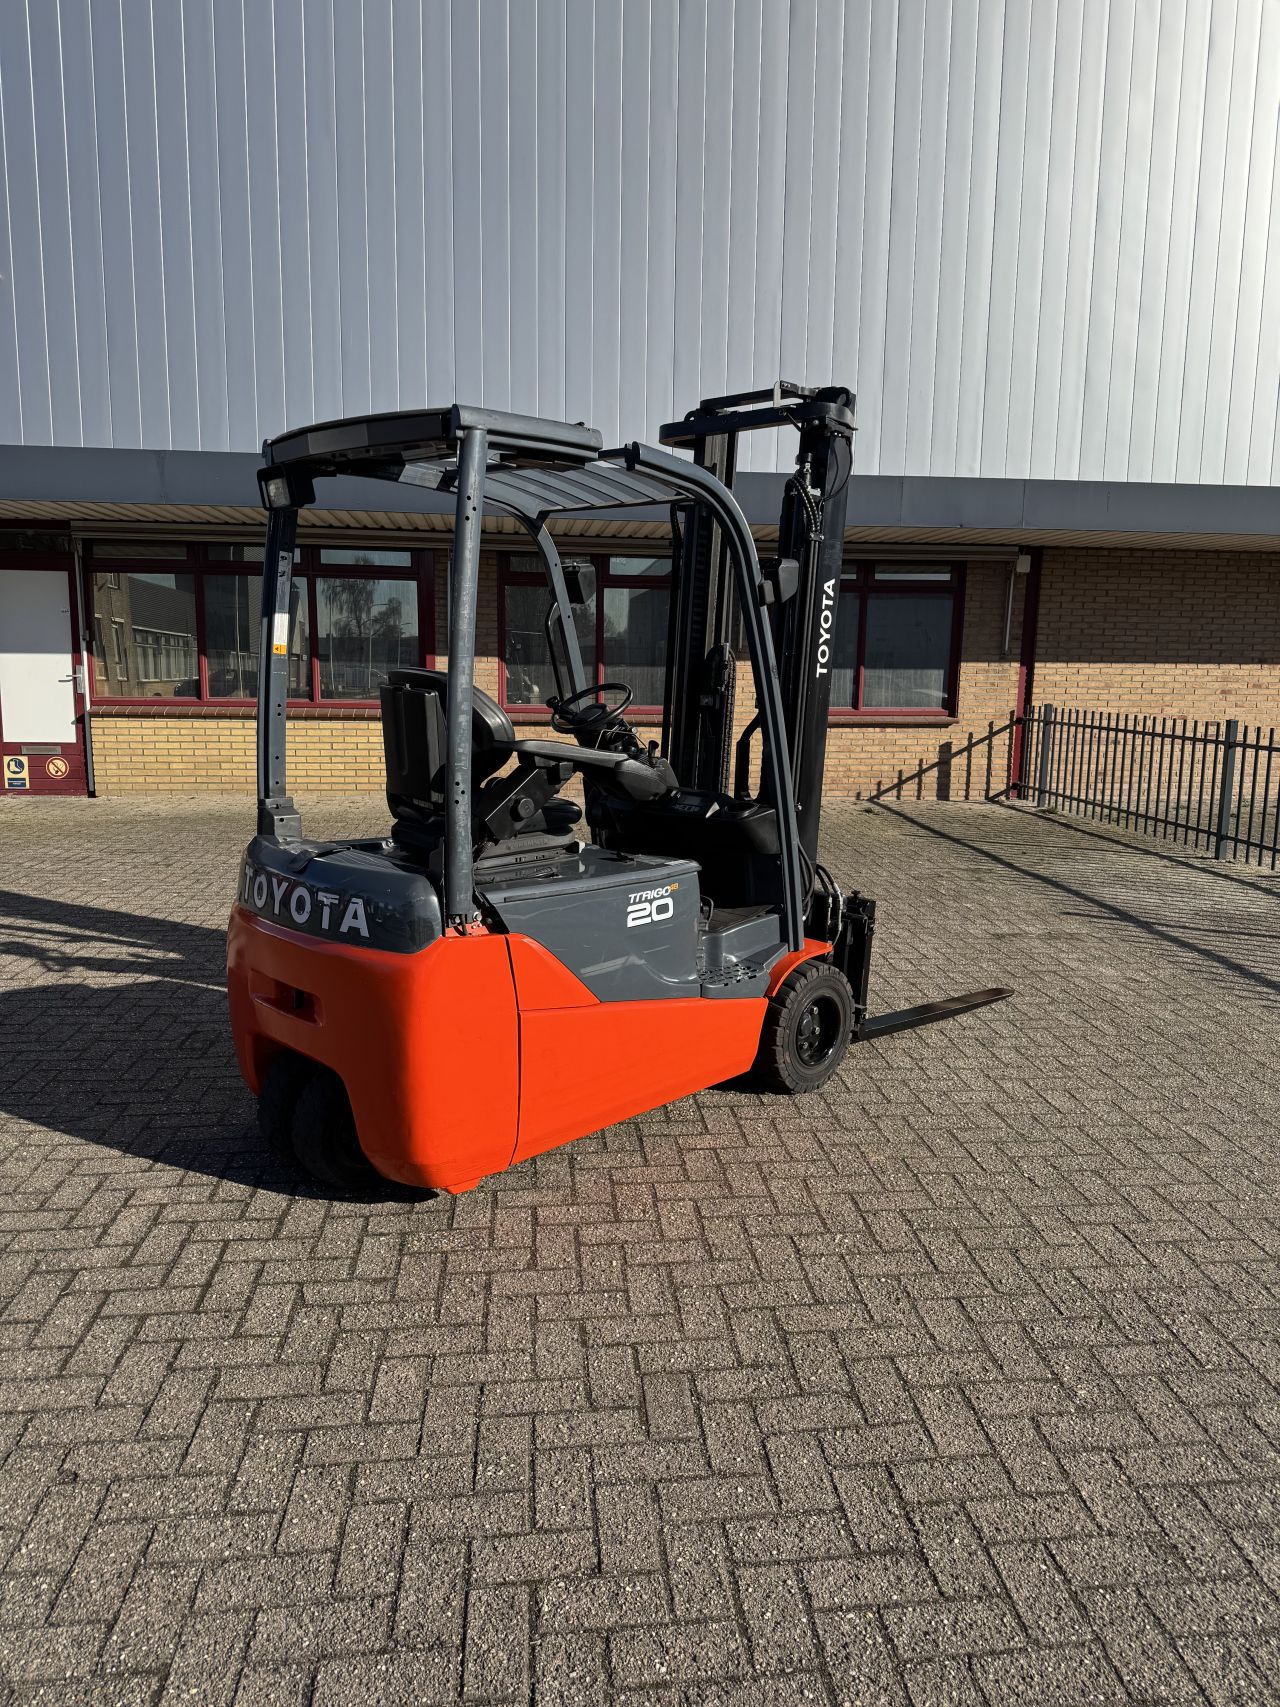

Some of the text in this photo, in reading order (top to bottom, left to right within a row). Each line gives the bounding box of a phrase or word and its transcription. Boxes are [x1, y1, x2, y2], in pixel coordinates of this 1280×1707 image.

[816, 578, 836, 678] TOYOTA
[244, 864, 370, 938] TOYOTA
[627, 897, 674, 928] 20
